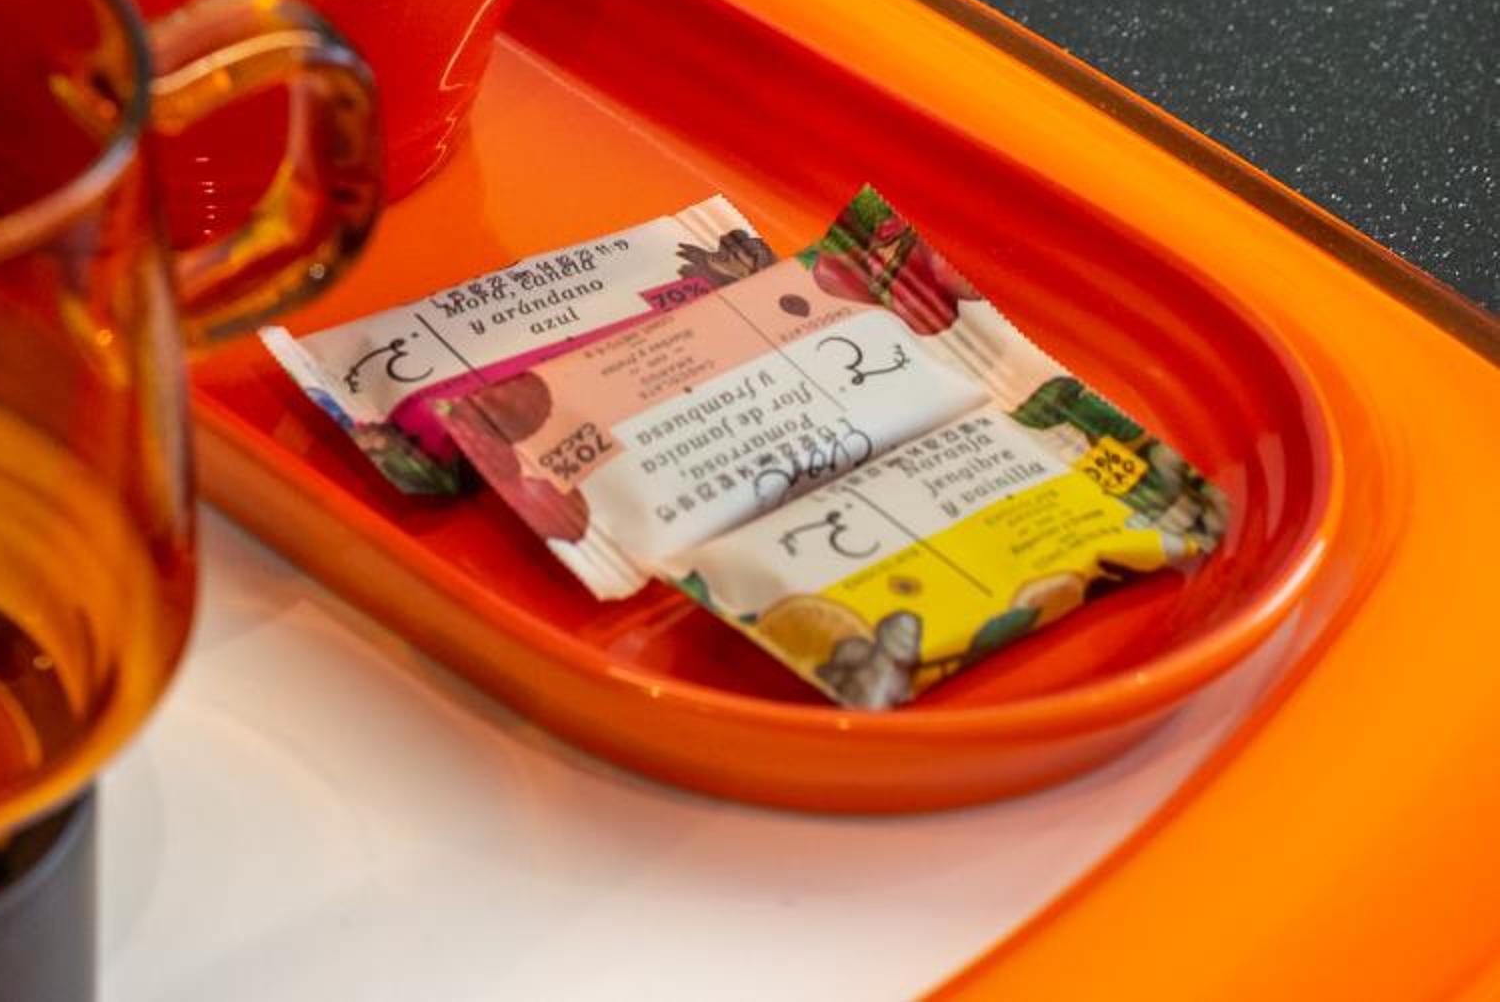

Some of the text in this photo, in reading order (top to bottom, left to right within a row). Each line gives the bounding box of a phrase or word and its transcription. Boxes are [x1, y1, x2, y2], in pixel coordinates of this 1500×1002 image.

[445, 285, 516, 318] Mora,
[469, 278, 604, 335] y arúndano
[530, 306, 581, 335] azul
[636, 370, 775, 447] y frambuesa
[641, 382, 814, 474] flor de jamaica
[538, 422, 597, 467] CACAO
[552, 433, 613, 481] 70%
[679, 413, 815, 480] Pomarrosa,
[941, 500, 960, 517] y
